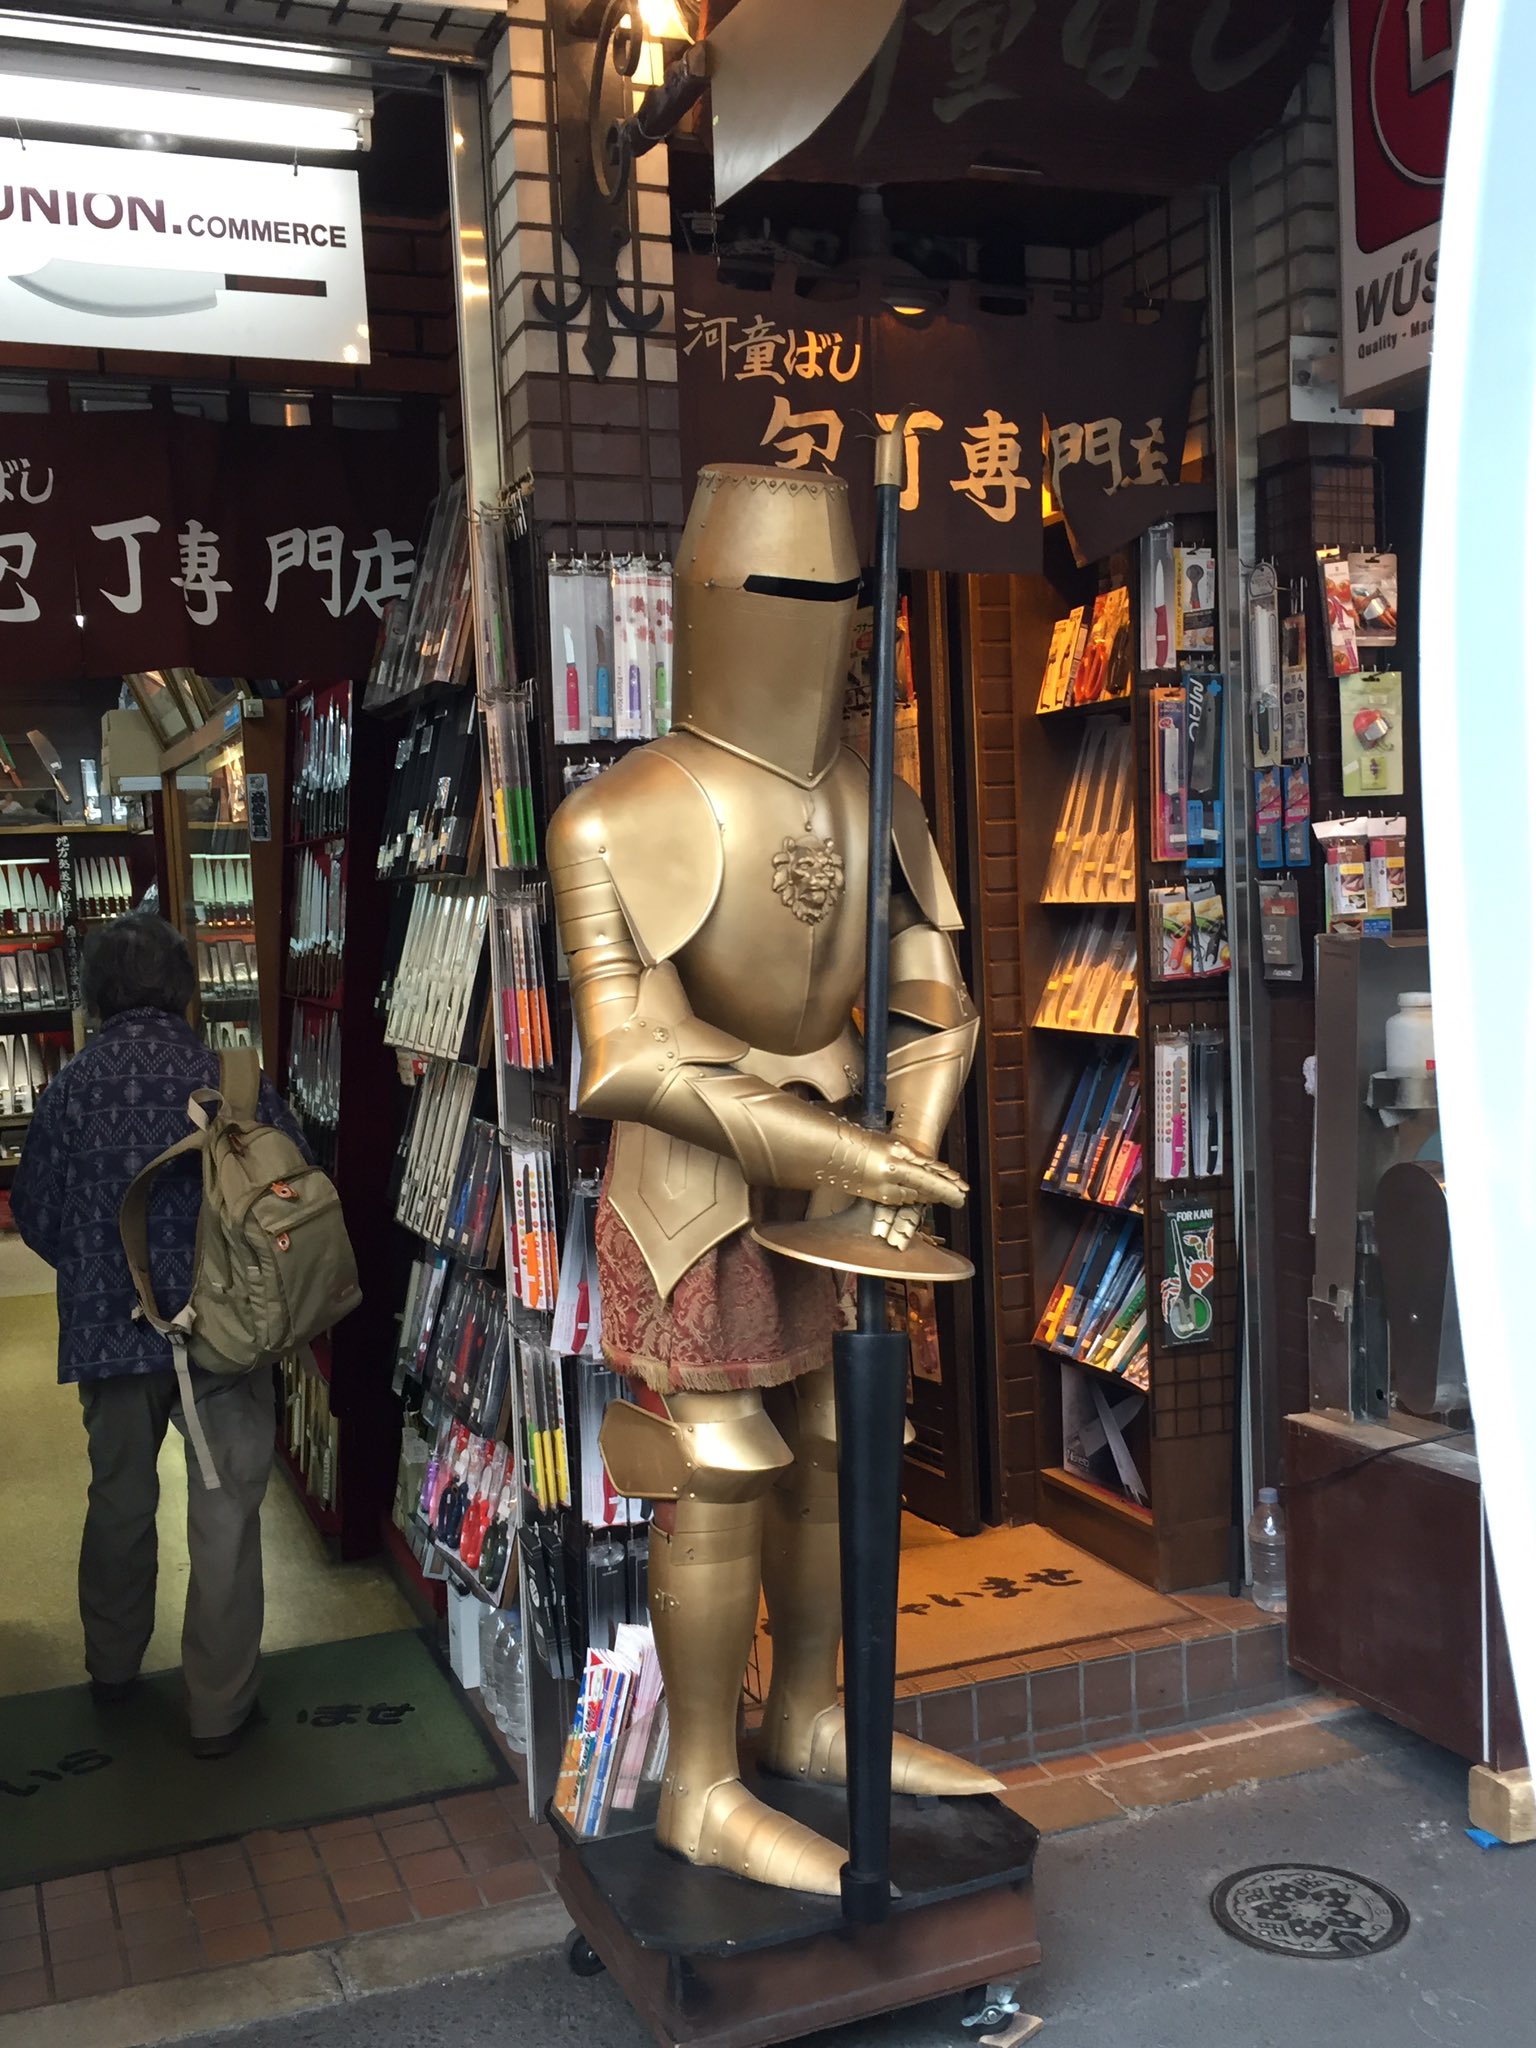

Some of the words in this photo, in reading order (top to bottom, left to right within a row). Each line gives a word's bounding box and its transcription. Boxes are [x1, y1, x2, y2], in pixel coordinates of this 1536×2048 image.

[187, 214, 347, 248] COMMERCE
[683, 307, 860, 385] 河童ばし
[1358, 332, 1397, 359] Quality
